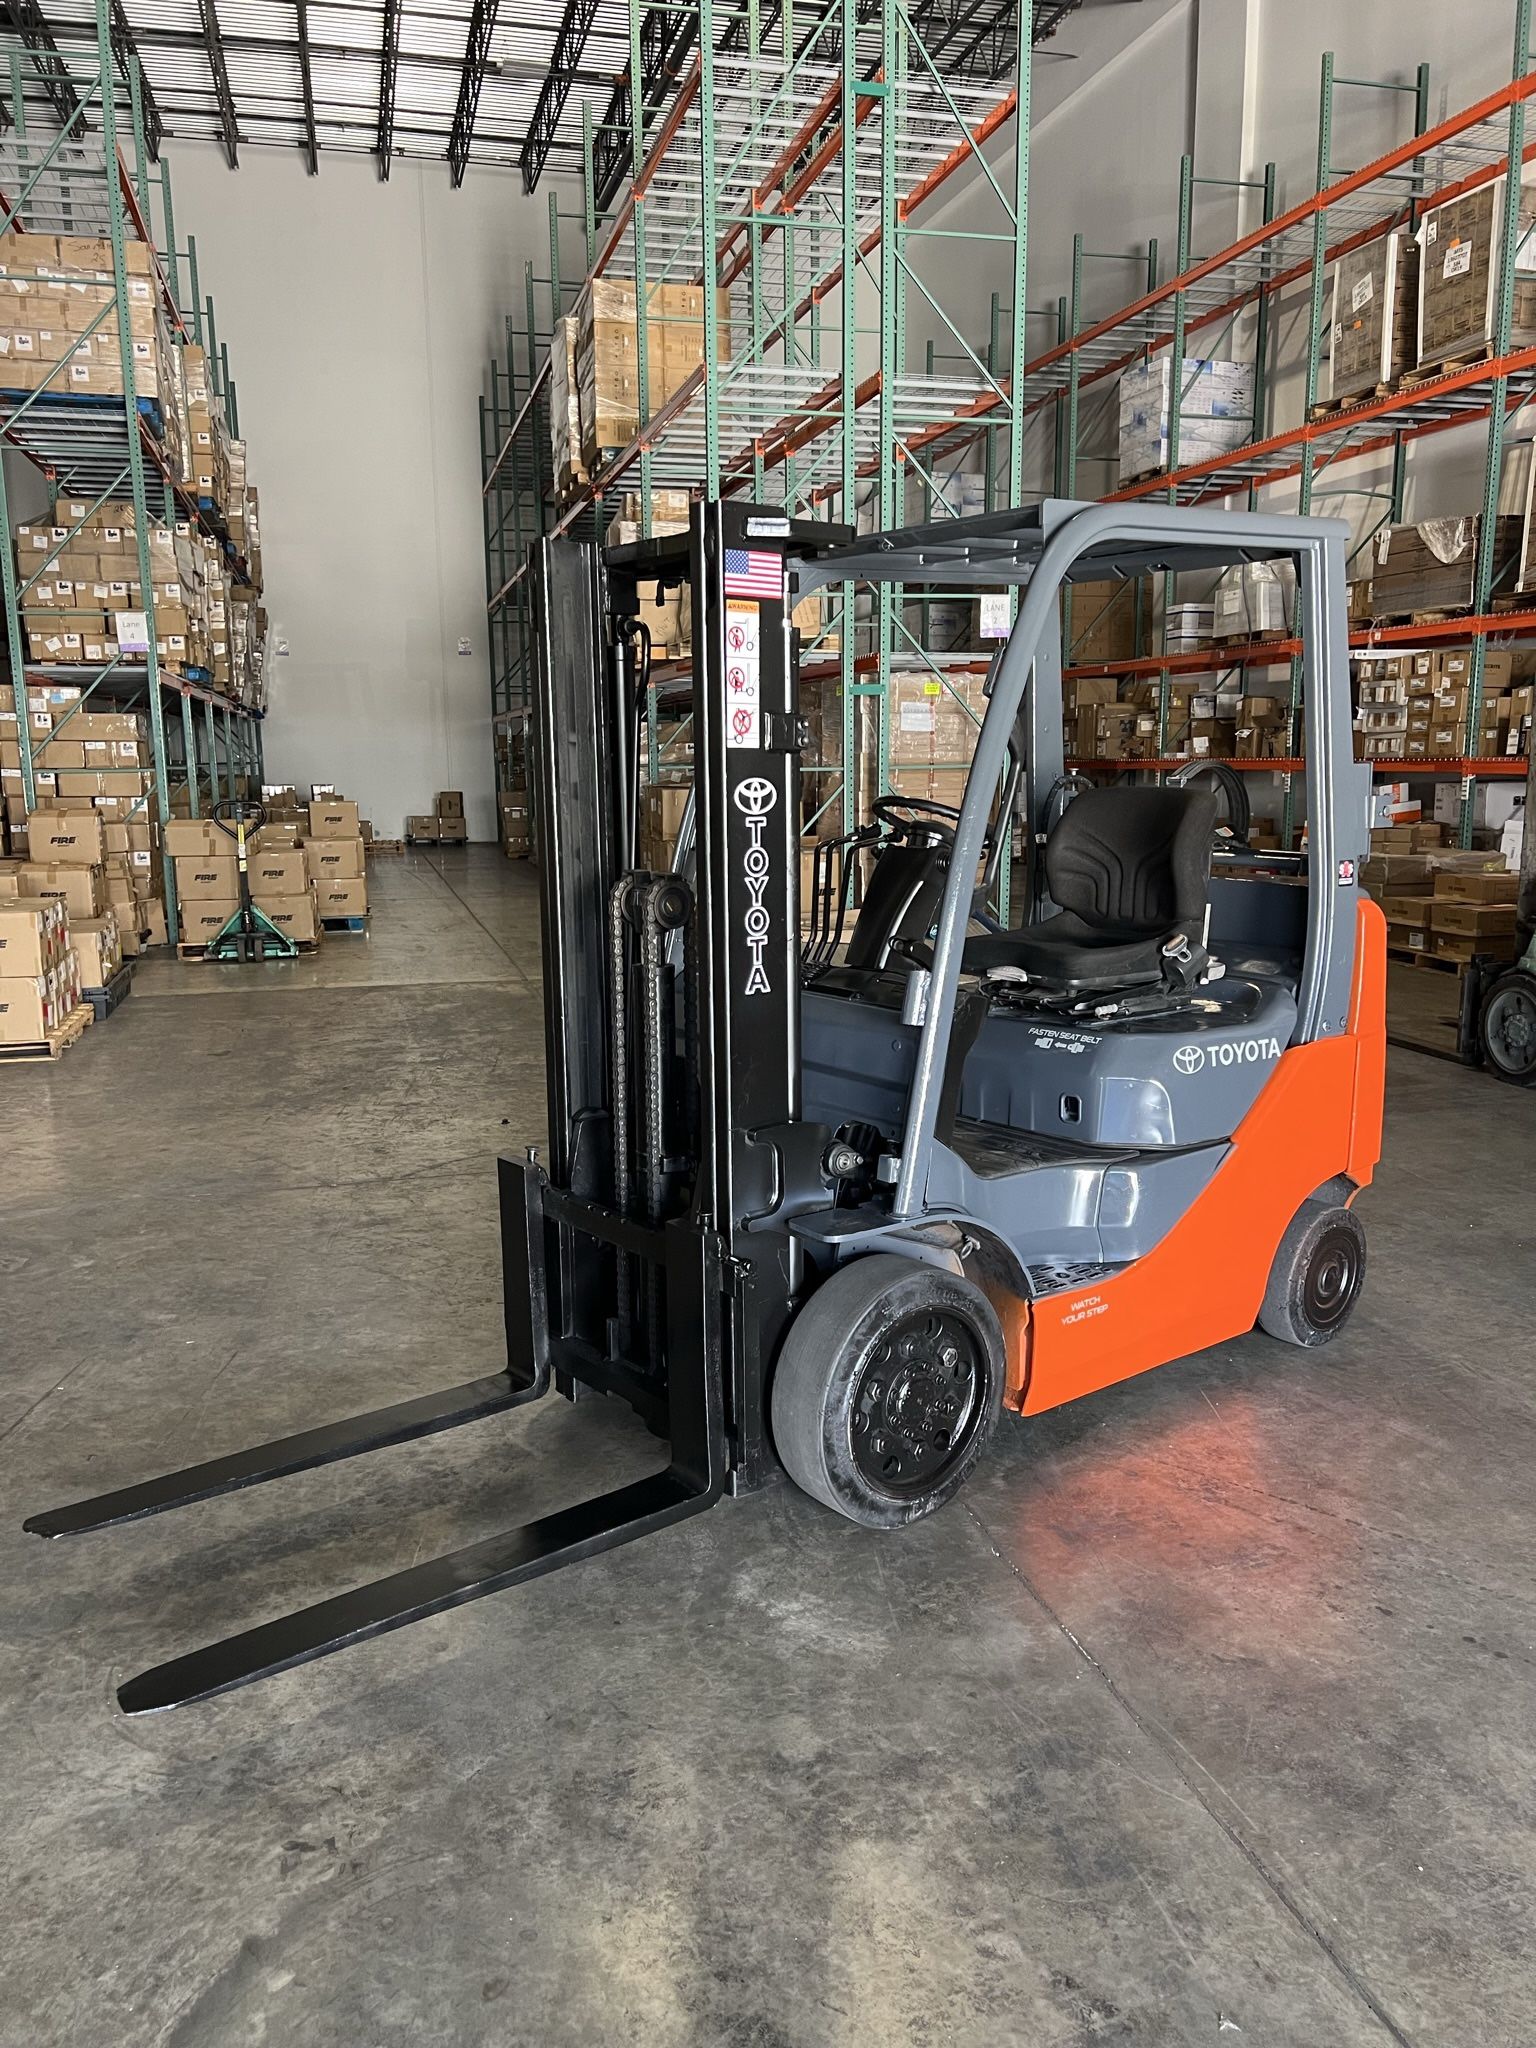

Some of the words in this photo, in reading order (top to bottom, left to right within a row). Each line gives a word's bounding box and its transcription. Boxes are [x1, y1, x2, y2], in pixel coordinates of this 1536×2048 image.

[986, 604, 1005, 612] LANE
[50, 836, 77, 845] FIRE
[194, 873, 218, 881] FIRE
[262, 869, 285, 877] FIRE
[328, 893, 349, 901] FIRE
[743, 816, 771, 995] TOYOTA
[200, 916, 224, 924] FIRE
[271, 914, 293, 922] FIRE
[1028, 1027, 1060, 1038] FASTEN
[1059, 1031, 1081, 1041] SEAT
[1080, 1034, 1103, 1045] BELT
[1206, 1037, 1282, 1068] TOYOTA
[1071, 1295, 1101, 1312] WATCH
[1061, 1311, 1086, 1326] YOUR
[1086, 1303, 1109, 1319] STEP
